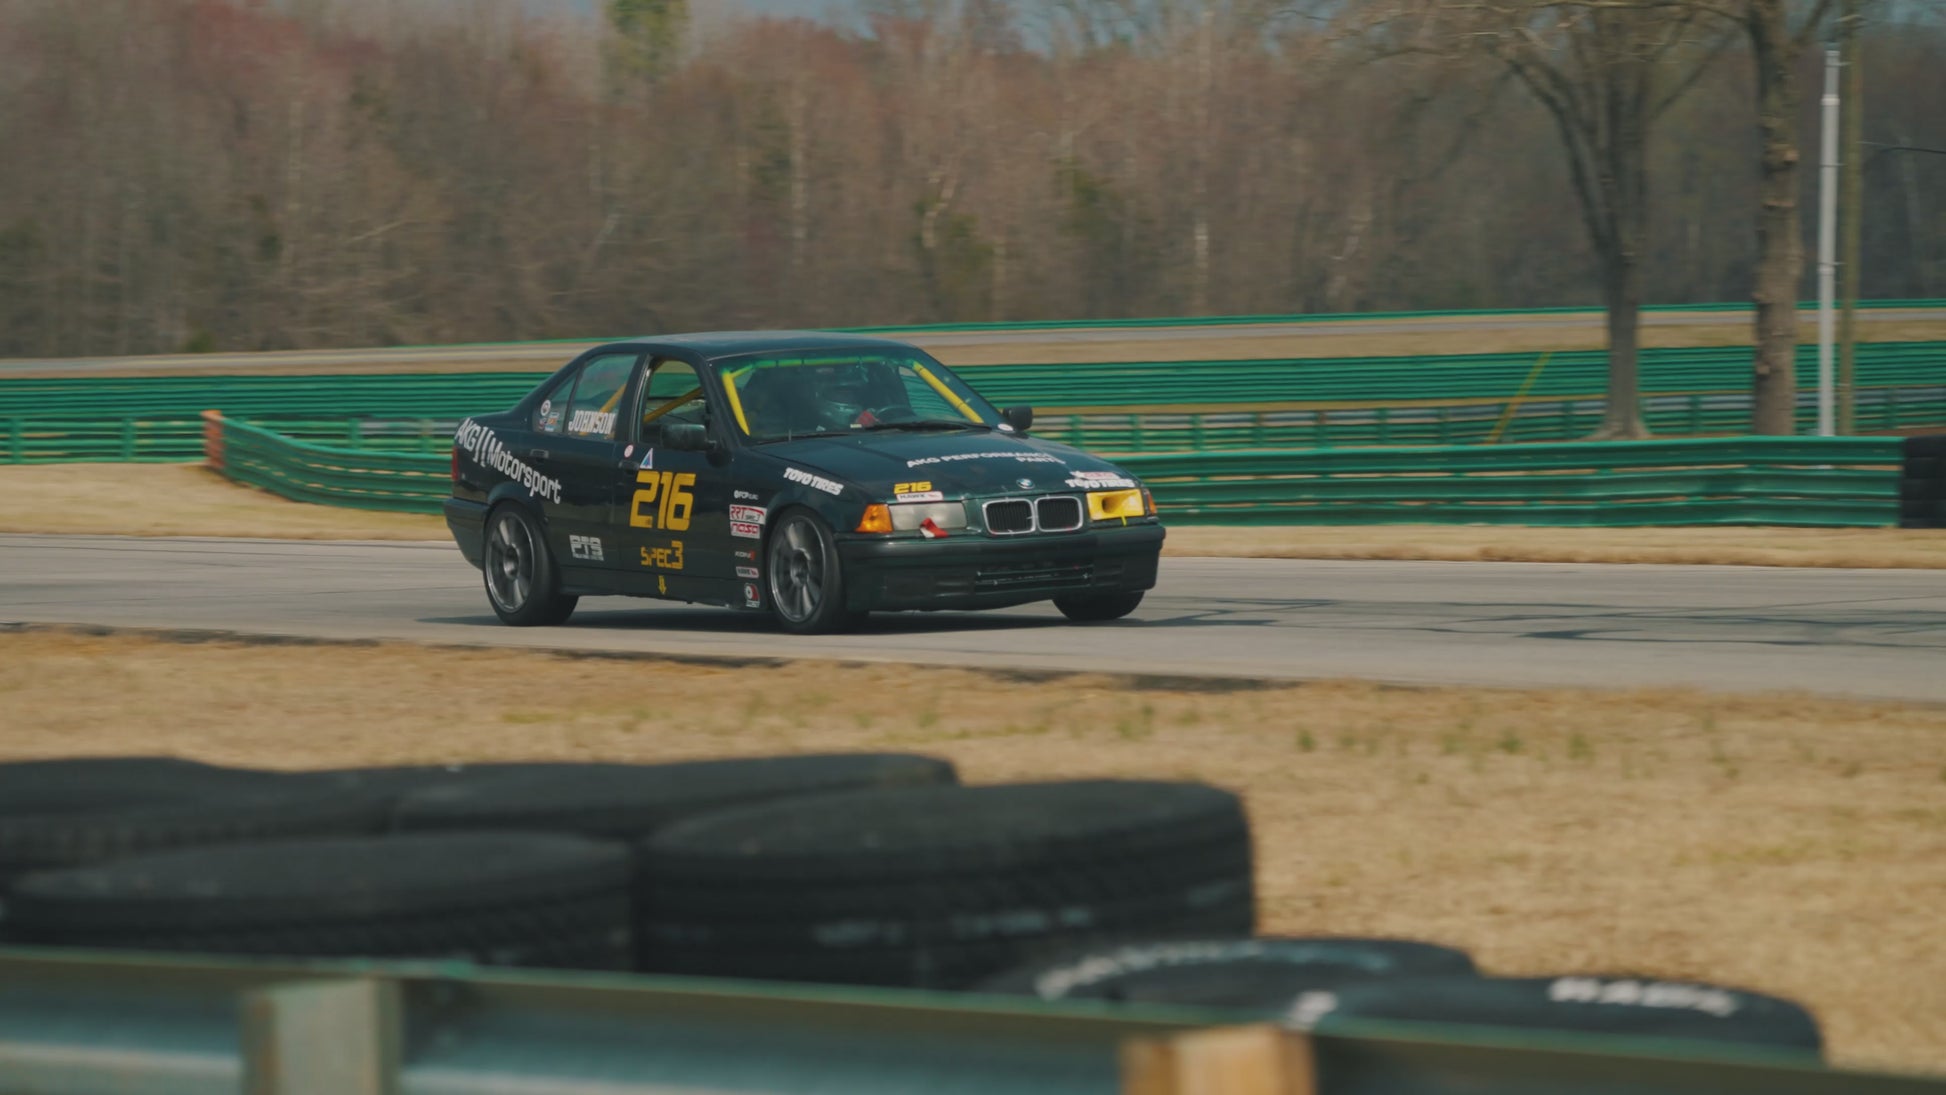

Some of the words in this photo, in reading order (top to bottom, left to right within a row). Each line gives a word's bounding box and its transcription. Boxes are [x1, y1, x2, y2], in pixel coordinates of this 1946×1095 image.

[568, 410, 616, 434] JOHNSON
[454, 417, 478, 452] AKG
[487, 440, 562, 504] Motorsport
[783, 467, 813, 485] TOYO
[811, 476, 844, 496] TIRES
[894, 481, 932, 494] 216
[630, 470, 697, 531] 216
